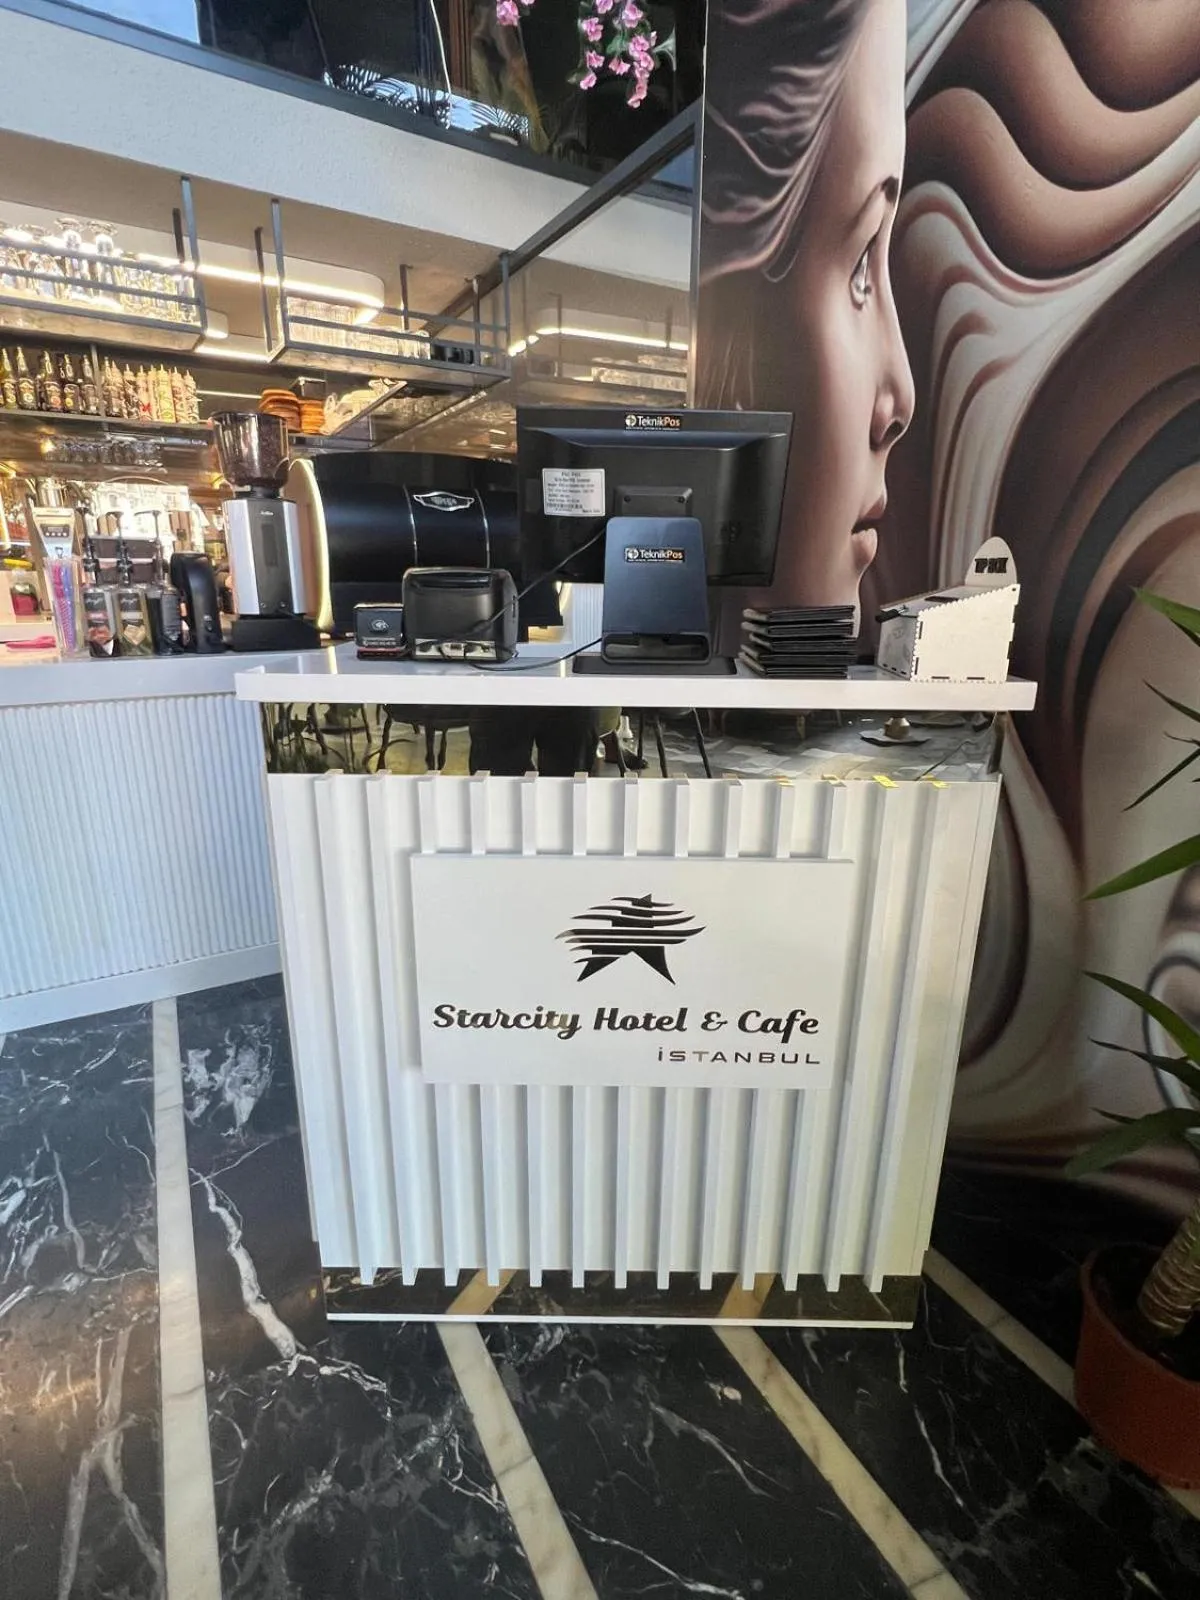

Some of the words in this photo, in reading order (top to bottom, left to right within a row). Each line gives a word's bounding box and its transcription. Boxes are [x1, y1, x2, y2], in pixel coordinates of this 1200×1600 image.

[637, 415, 681, 427] TeknikPos
[639, 549, 684, 559] TeknikPos
[433, 1004, 582, 1040] Starcity
[594, 1008, 688, 1032] Hotel
[701, 1012, 728, 1031] &
[738, 1009, 818, 1044] Cafe
